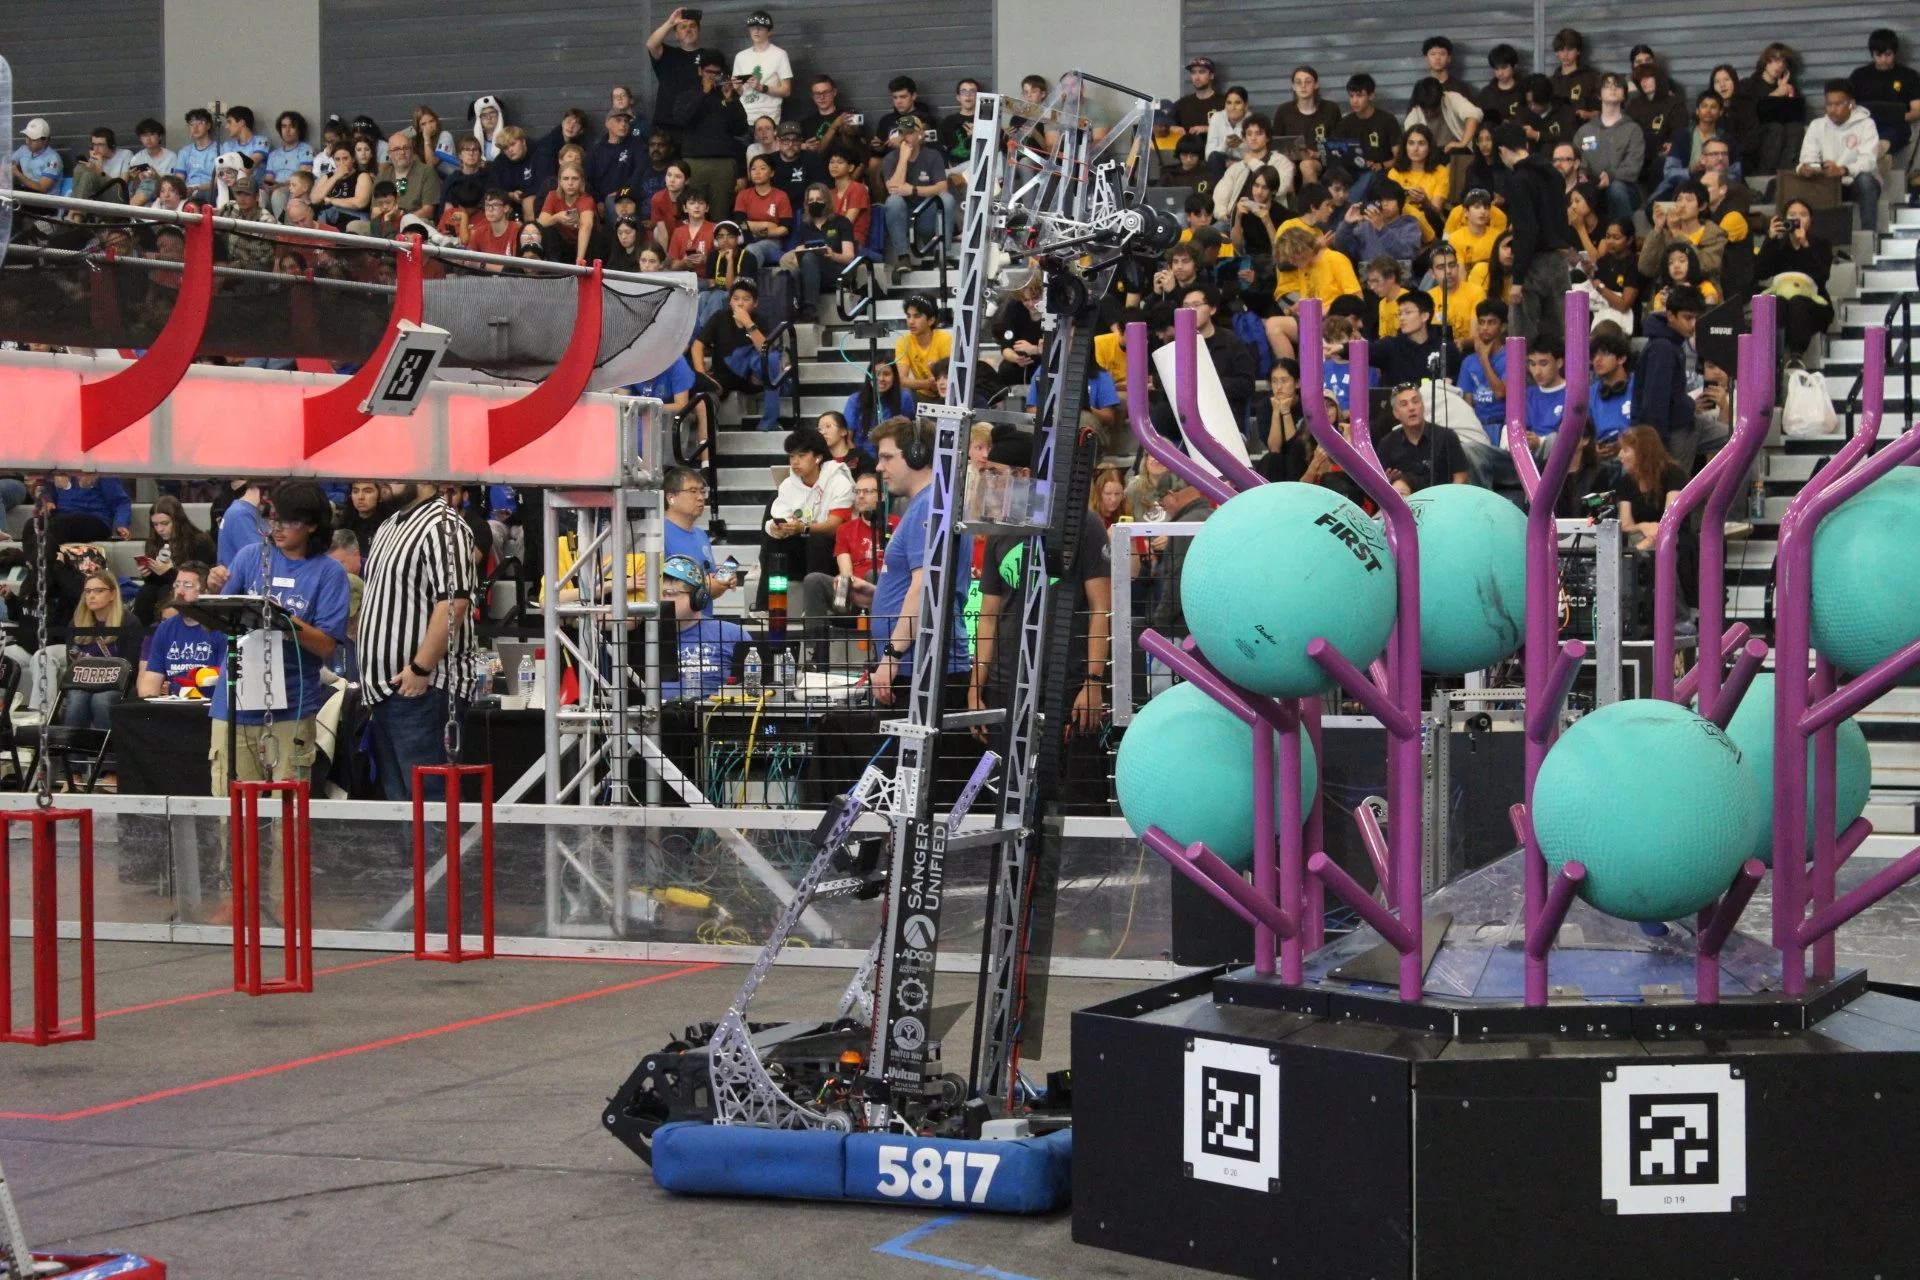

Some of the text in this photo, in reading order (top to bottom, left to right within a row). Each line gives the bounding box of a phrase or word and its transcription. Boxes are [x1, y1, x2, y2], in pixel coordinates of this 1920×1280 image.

[1313, 513, 1383, 572] FIRST
[73, 666, 121, 684] TORRES
[907, 823, 930, 909] SANGER
[924, 825, 946, 911] UNIFIED
[901, 948, 934, 962] ADCO
[903, 991, 922, 999] WCP
[890, 1049, 911, 1059] UNITED
[911, 1053, 923, 1061] WAY
[876, 1145, 1000, 1204] 5817
[1223, 1167, 1238, 1177] ID 20
[1663, 1195, 1685, 1205] ID 19
